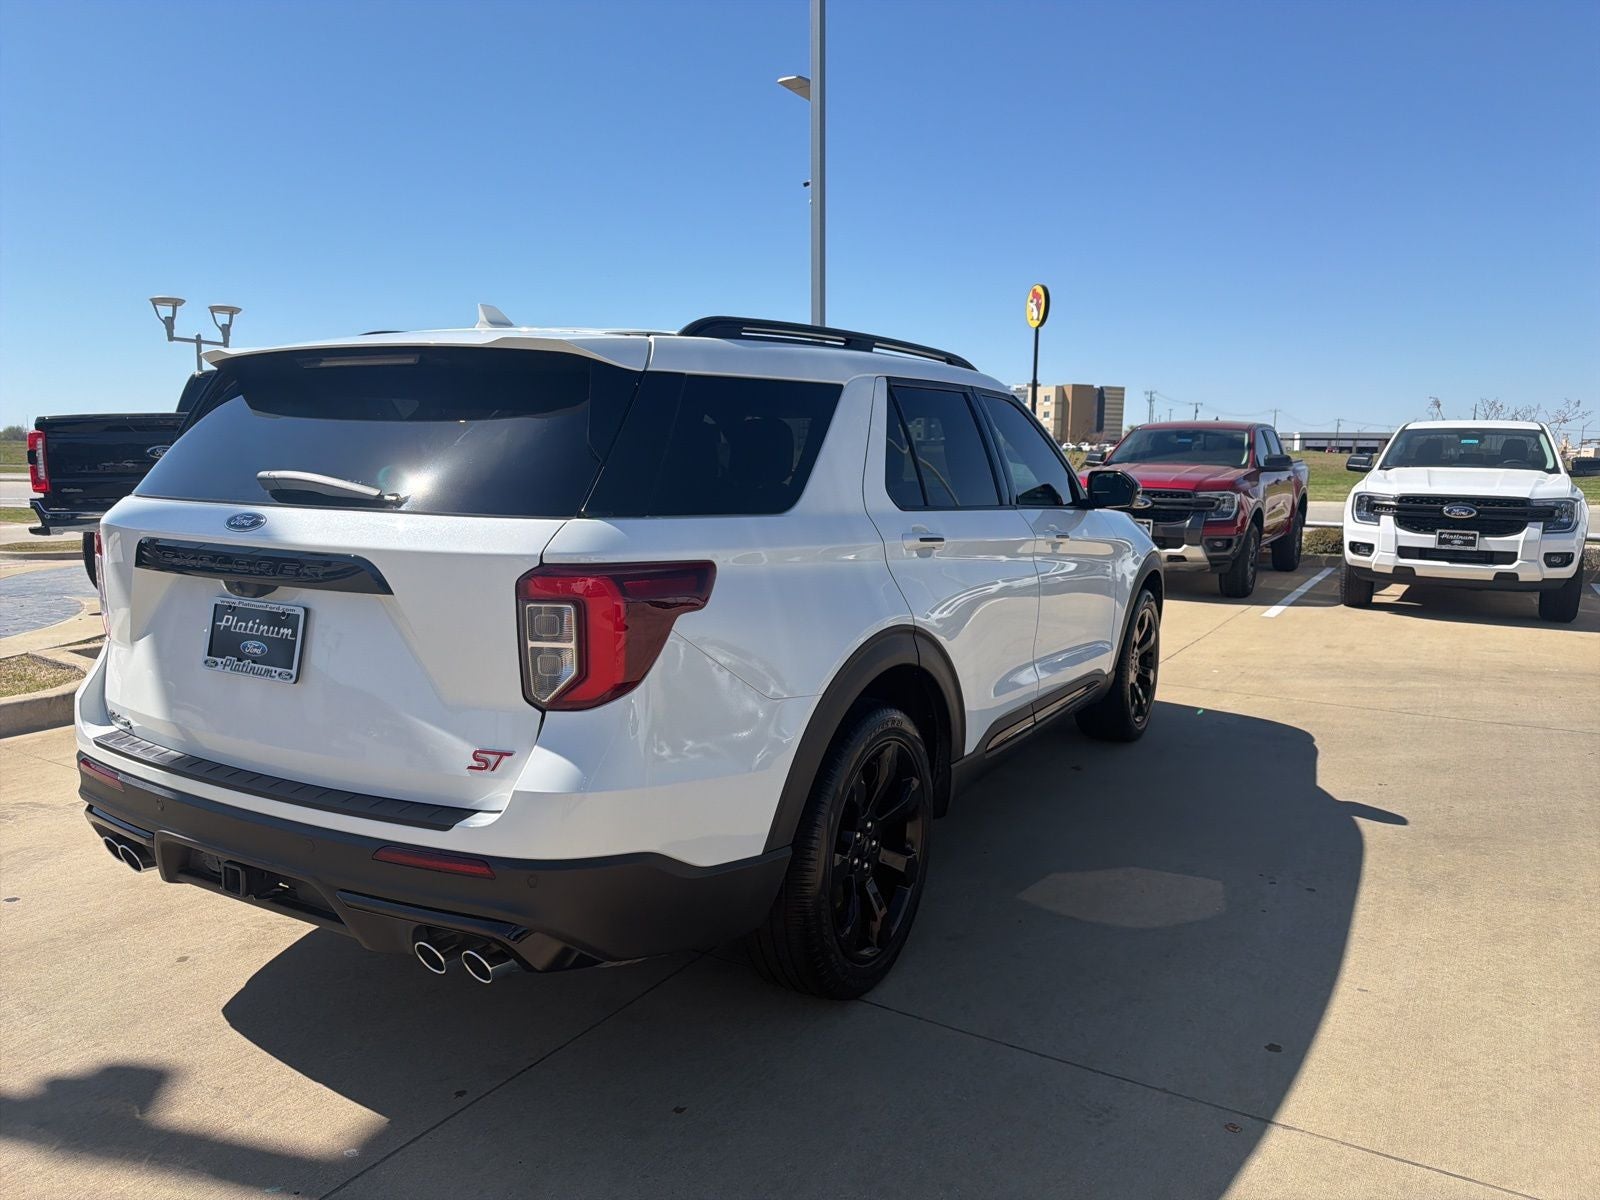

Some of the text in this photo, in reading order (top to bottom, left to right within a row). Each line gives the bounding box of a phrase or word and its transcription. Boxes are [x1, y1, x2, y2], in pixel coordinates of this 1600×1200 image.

[230, 514, 257, 527] Ford
[159, 550, 325, 579] EXPLORER
[220, 600, 296, 613] www.PlatinumFord.com
[216, 615, 296, 640] Platinum
[245, 642, 262, 655] Ford
[222, 657, 276, 679] Platinum
[466, 748, 516, 772] ST
